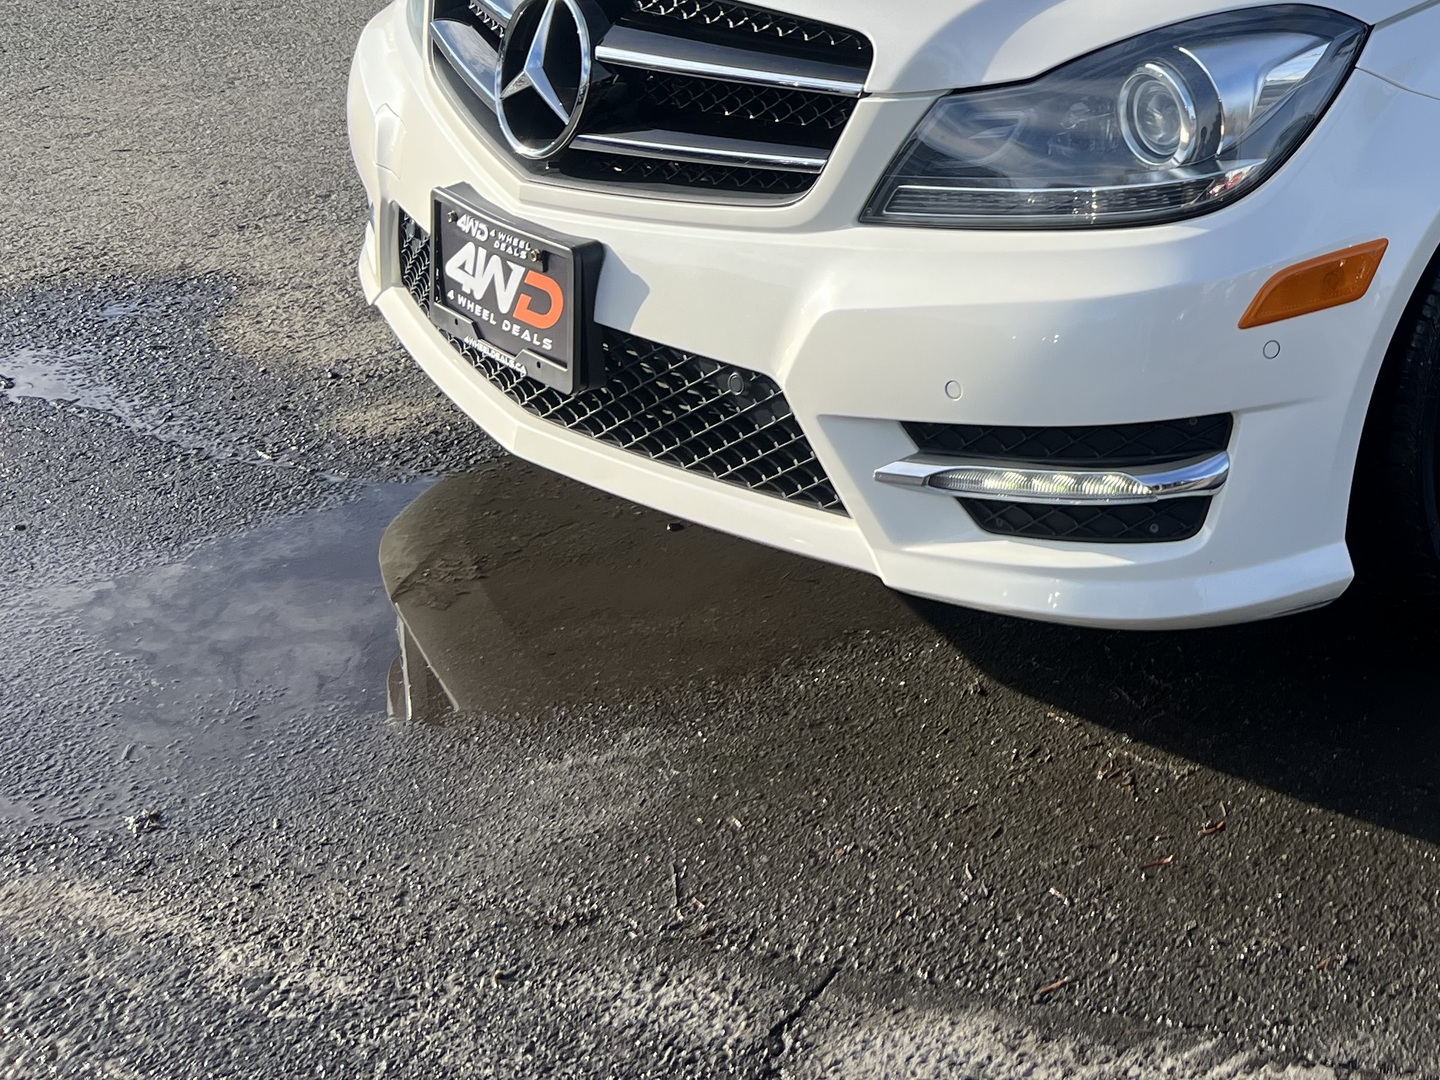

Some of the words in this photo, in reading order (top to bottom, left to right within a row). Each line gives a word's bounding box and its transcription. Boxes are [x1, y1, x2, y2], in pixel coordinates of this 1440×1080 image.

[456, 214, 489, 241] 4WD
[489, 229, 496, 237] 4
[498, 231, 531, 251] WHEEL
[493, 240, 528, 259] DEALS
[445, 241, 564, 329] 4WD
[447, 290, 454, 300] 4
[457, 294, 497, 325] WHEEL
[502, 319, 553, 350] DEALS
